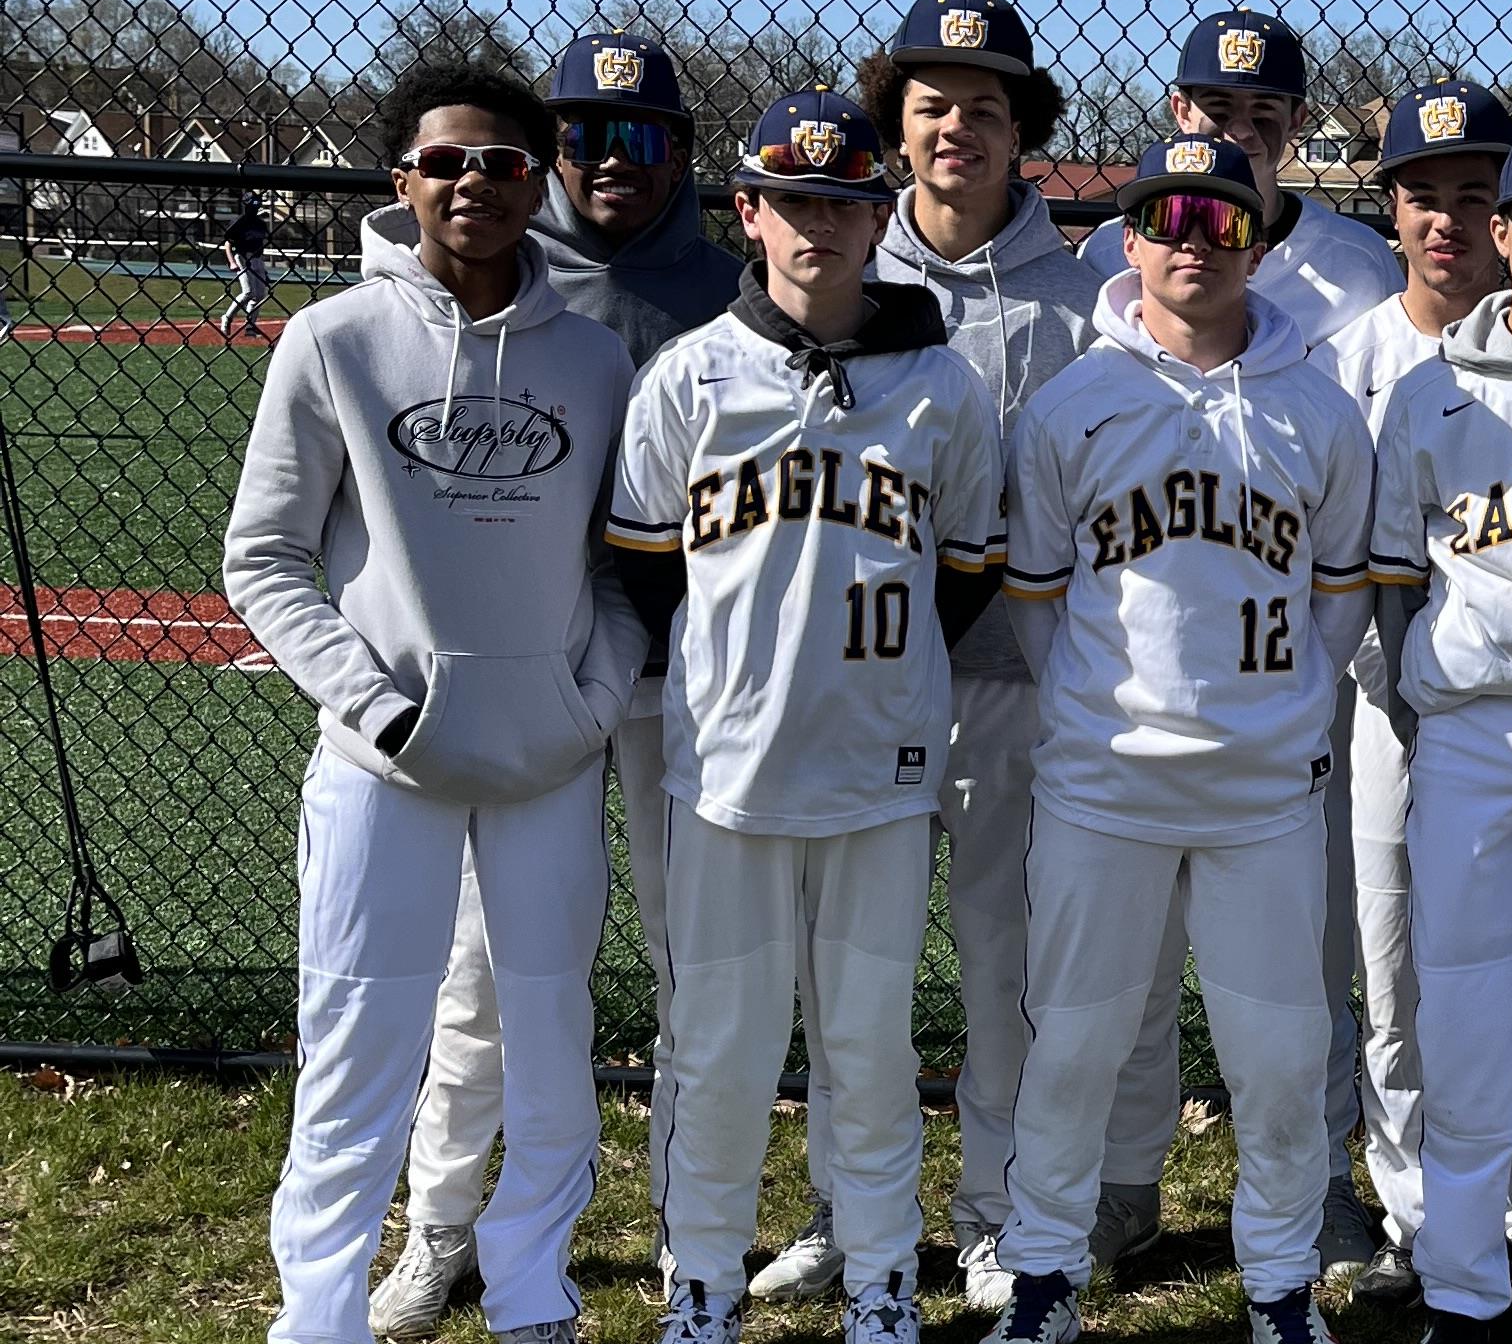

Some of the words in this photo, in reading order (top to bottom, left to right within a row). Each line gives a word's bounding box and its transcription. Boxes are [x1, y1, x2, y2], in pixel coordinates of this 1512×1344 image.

[409, 406, 553, 475] Supply
[433, 487, 488, 508] Superior
[491, 485, 541, 502] Collective
[687, 446, 932, 555] EAGLES
[1089, 468, 1301, 577] EAGLES
[843, 579, 911, 662] 10
[1238, 596, 1295, 674] 12
[907, 751, 919, 763] M
[1319, 761, 1327, 772] L
